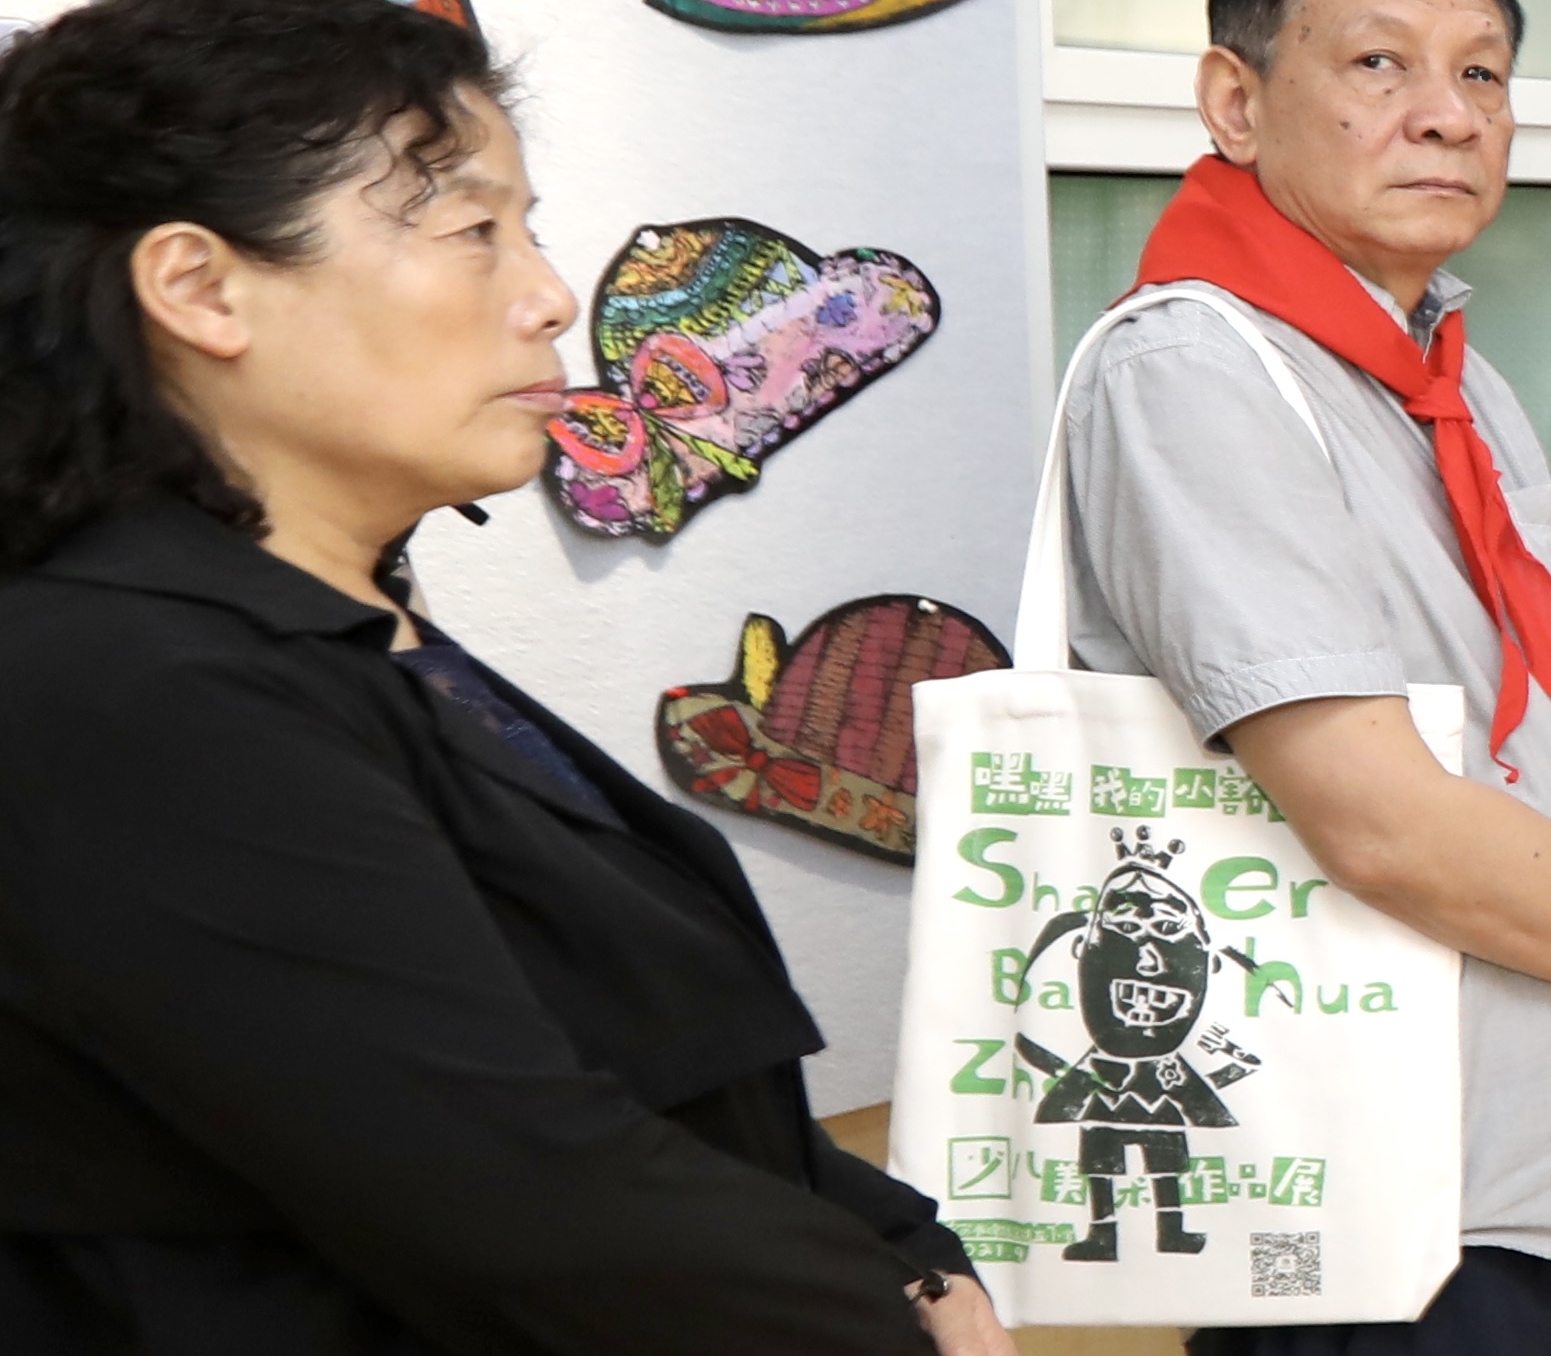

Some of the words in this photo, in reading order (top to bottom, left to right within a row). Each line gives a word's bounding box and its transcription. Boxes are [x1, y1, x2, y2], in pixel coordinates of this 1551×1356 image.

[952, 827, 1110, 912] Sha
[1200, 855, 1329, 921] er
[1244, 935, 1398, 1018] hua
[964, 1242, 1026, 1264] 021.9
